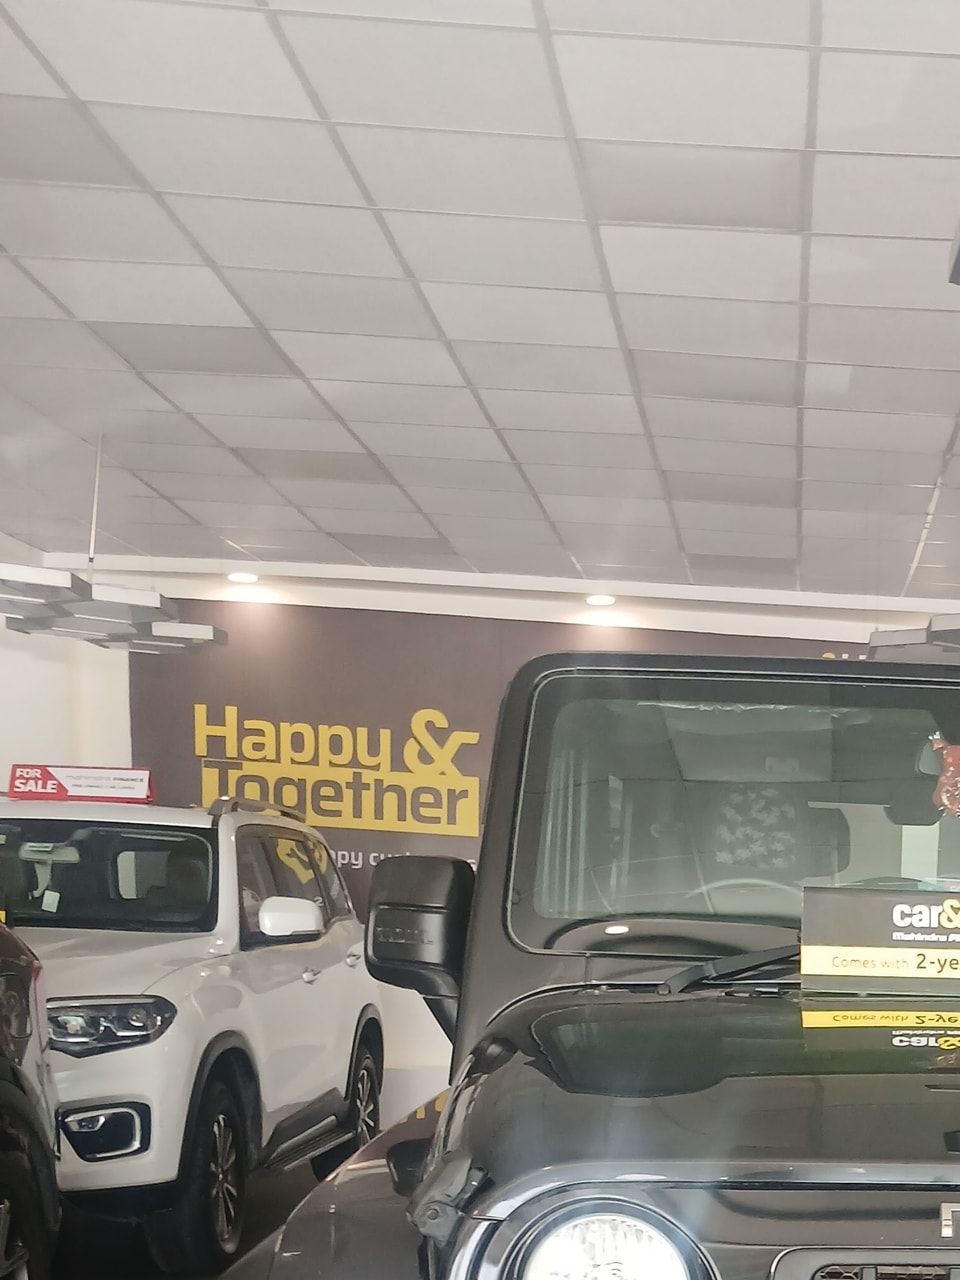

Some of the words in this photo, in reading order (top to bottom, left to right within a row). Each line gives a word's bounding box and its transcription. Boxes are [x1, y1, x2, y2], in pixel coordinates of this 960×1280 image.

[193, 703, 392, 774] Happy
[403, 707, 480, 777] &
[15, 768, 42, 779] FOR
[13, 779, 58, 793] SALE
[203, 759, 469, 826] Together
[832, 955, 877, 969] Comes
[881, 957, 909, 970] with
